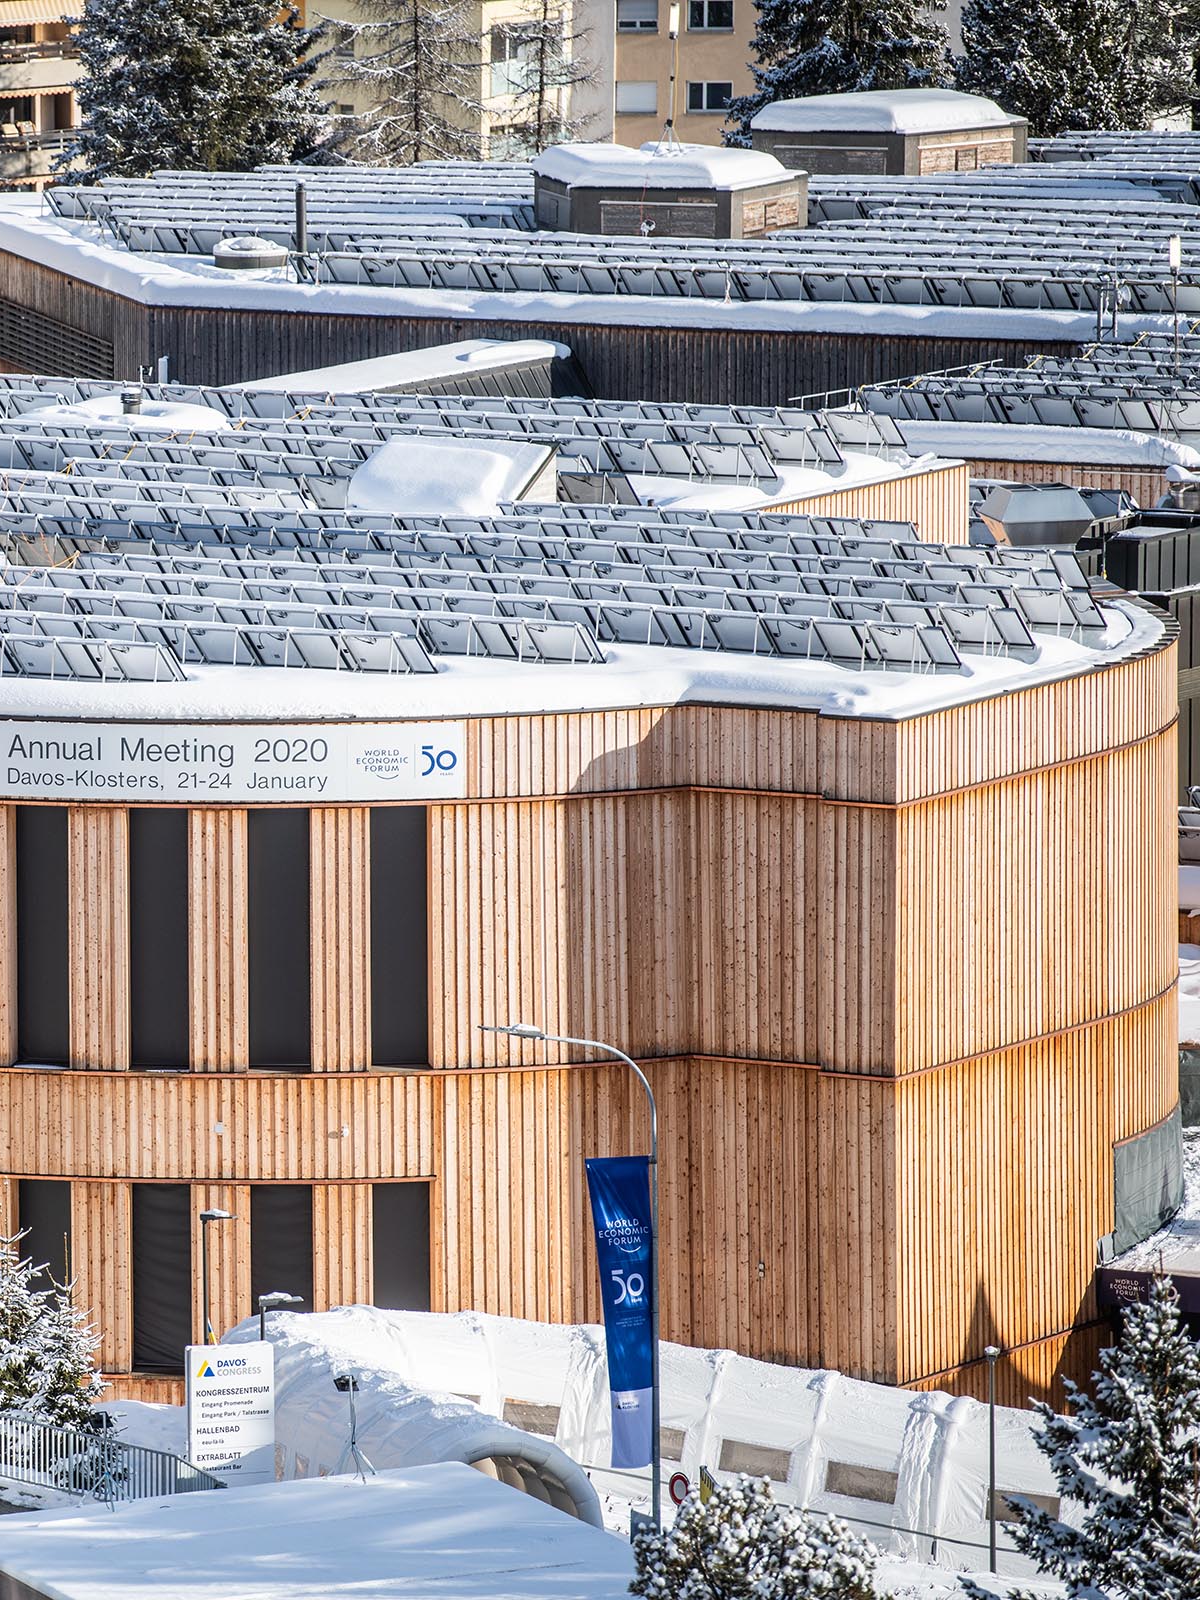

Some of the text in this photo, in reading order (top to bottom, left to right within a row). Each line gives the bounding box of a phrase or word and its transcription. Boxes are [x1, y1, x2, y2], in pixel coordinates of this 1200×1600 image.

[7, 734, 328, 768] Annual Meeting 2020
[364, 749, 400, 757] WORLD
[356, 756, 409, 765] ECONOMIC
[421, 745, 458, 777] 50
[364, 765, 400, 773] FORUM
[7, 767, 328, 793] Davos-Klosters, 21-24 January
[606, 1218, 640, 1229] WORLD
[598, 1226, 649, 1239] ECONOMIC
[608, 1236, 642, 1247] FORUM
[611, 1269, 645, 1305] 50
[1109, 1283, 1145, 1293] ECONOMIC
[1115, 1279, 1139, 1287] WORLD
[217, 1358, 247, 1368] DAVOS
[216, 1366, 262, 1377] CONGRESS
[195, 1385, 270, 1398] KONGRESSZENTRUM
[223, 1399, 254, 1407] Promenade
[196, 1425, 241, 1435] HALLENBAD
[196, 1451, 242, 1462] EXTRABLATT
